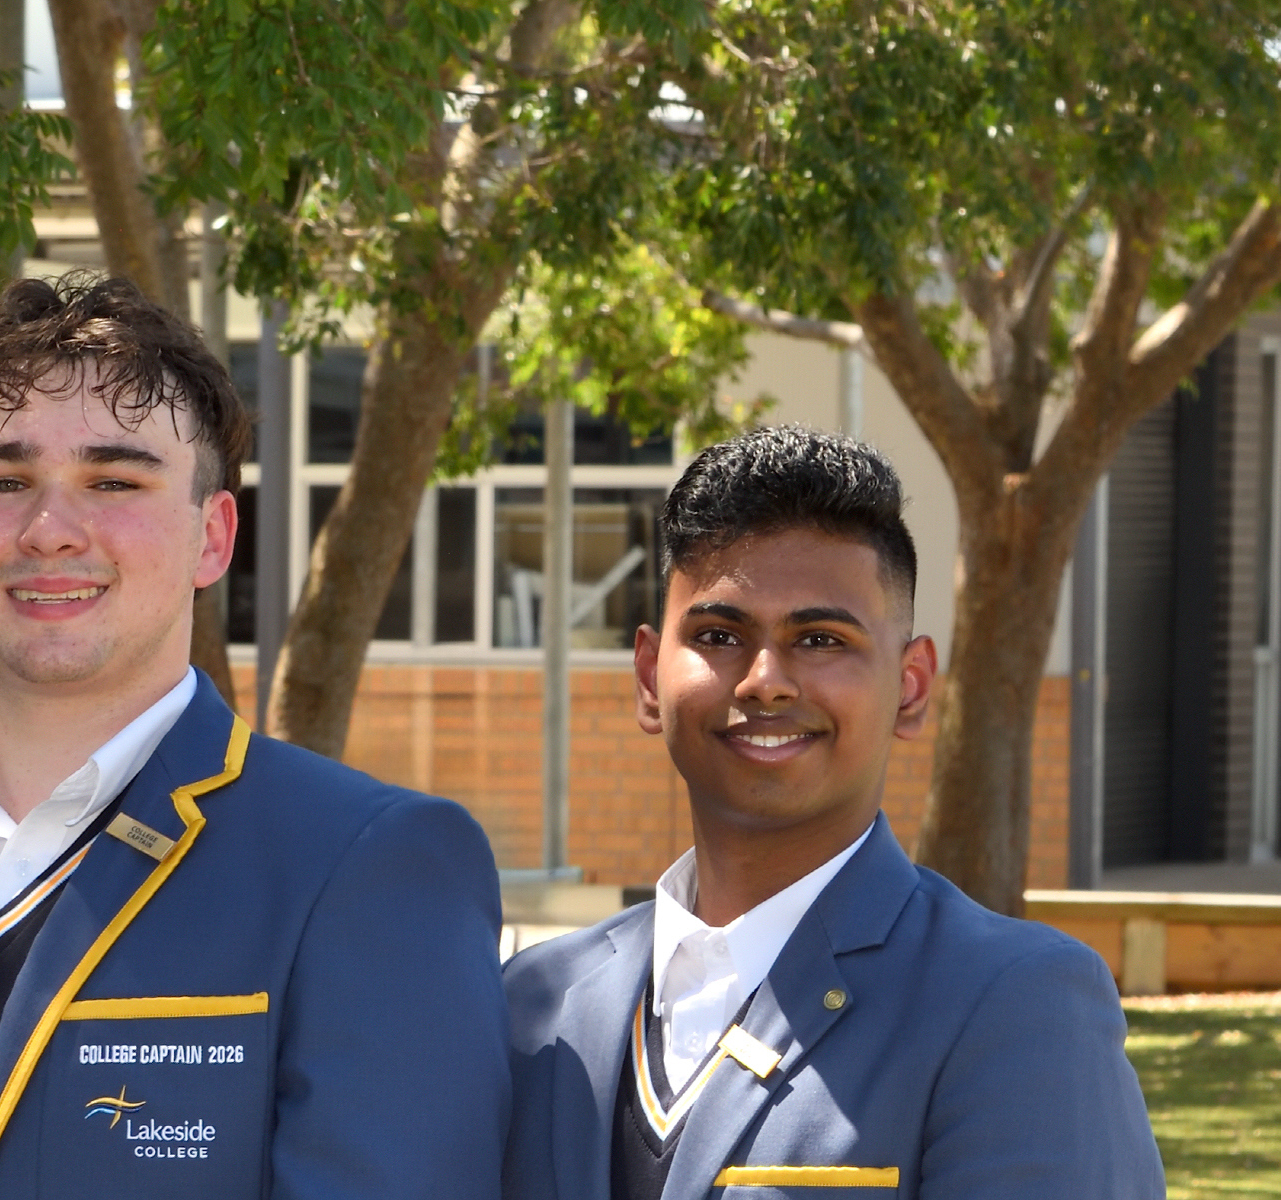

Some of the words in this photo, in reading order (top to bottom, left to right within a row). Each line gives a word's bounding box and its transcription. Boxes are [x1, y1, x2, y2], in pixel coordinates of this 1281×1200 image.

[127, 832, 154, 849] CAPTAIN
[131, 826, 159, 843] COLLEGE
[79, 1045, 136, 1065] COLLEGE
[140, 1045, 202, 1065] CAPTAIN
[208, 1045, 243, 1064] 2026
[126, 1118, 215, 1142] Lakeside
[134, 1145, 209, 1159] COLLEGE
